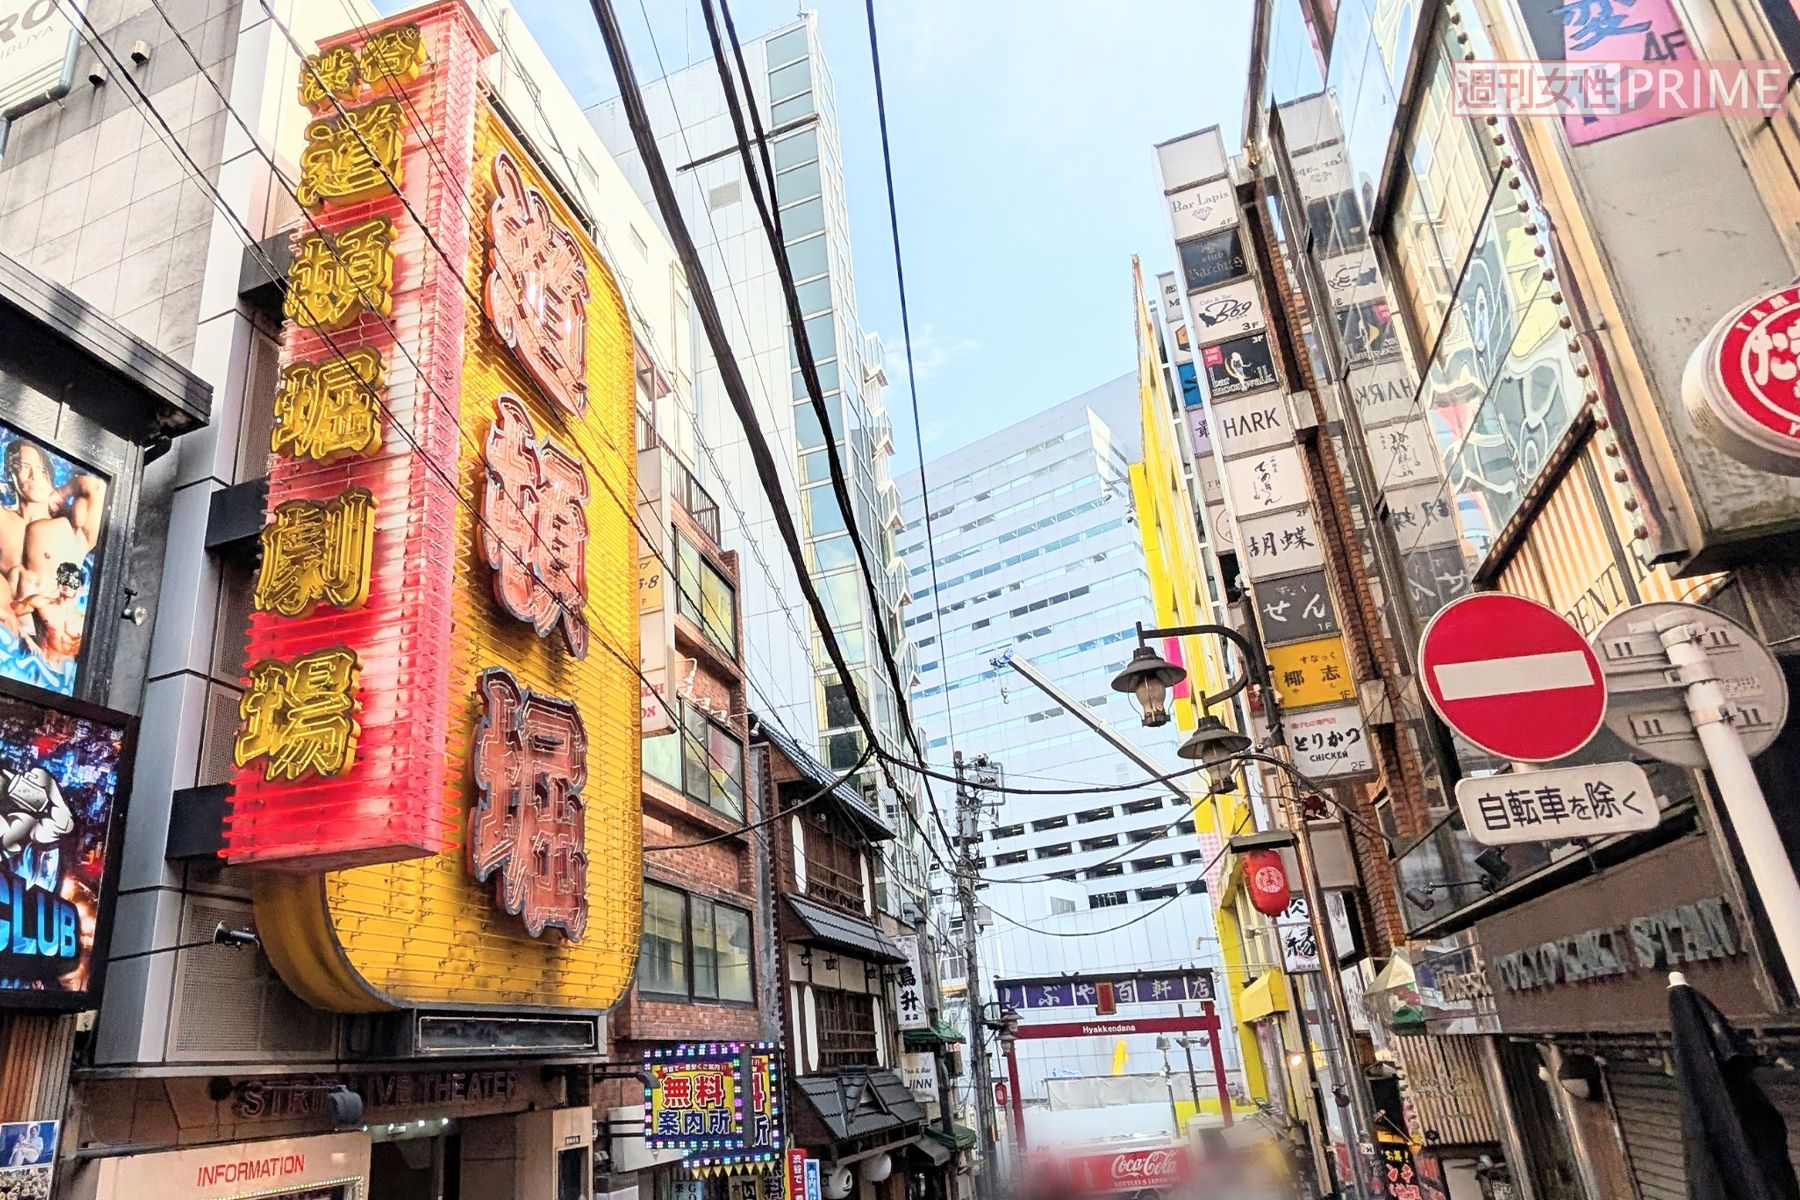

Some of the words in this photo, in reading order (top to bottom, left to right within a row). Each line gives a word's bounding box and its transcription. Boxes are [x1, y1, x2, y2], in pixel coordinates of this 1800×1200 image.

[1172, 200, 1195, 213] Bar
[1242, 321, 1259, 331] 3F
[1252, 335, 1264, 344] 3F
[1222, 407, 1281, 439] HARK
[1247, 526, 1315, 558] 胡蝶
[1262, 593, 1326, 622] せん
[1294, 727, 1361, 752] とりかつ
[1309, 750, 1348, 762] CHICKEN
[1350, 760, 1366, 771] 2F
[1478, 780, 1646, 831] 自転車を除く
[1082, 1024, 1136, 1035] Hyakkendana
[420, 1070, 520, 1102] THEATER
[662, 1075, 725, 1108] 無料
[657, 1109, 731, 1135] 案内所
[197, 1154, 305, 1187] INFORMATION
